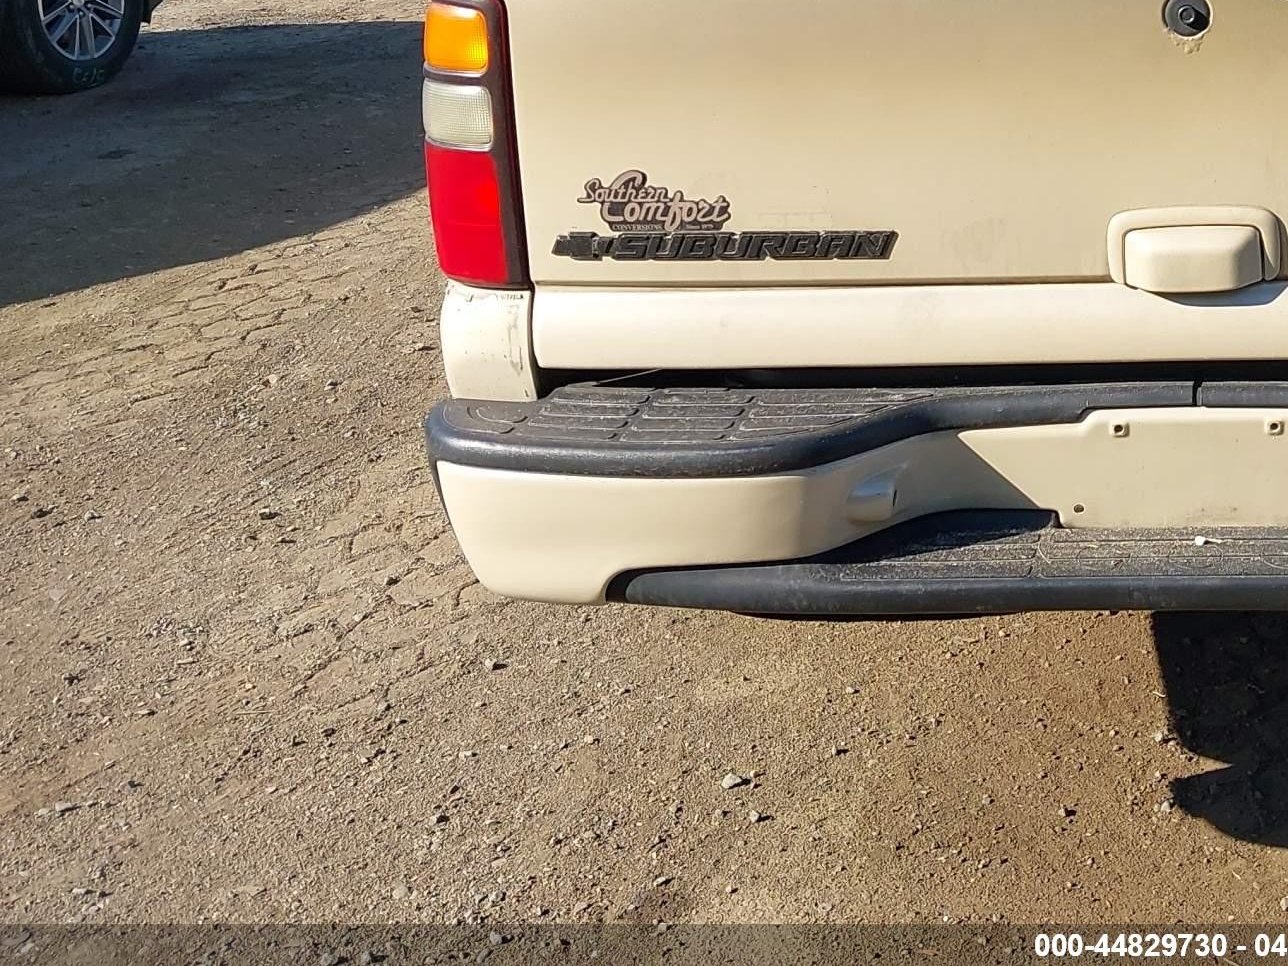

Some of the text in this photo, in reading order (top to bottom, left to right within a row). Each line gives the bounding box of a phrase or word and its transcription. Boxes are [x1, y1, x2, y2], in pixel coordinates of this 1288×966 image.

[577, 177, 671, 203] Southern
[601, 169, 732, 232] Comfort
[614, 232, 899, 261] SUBURBAN
